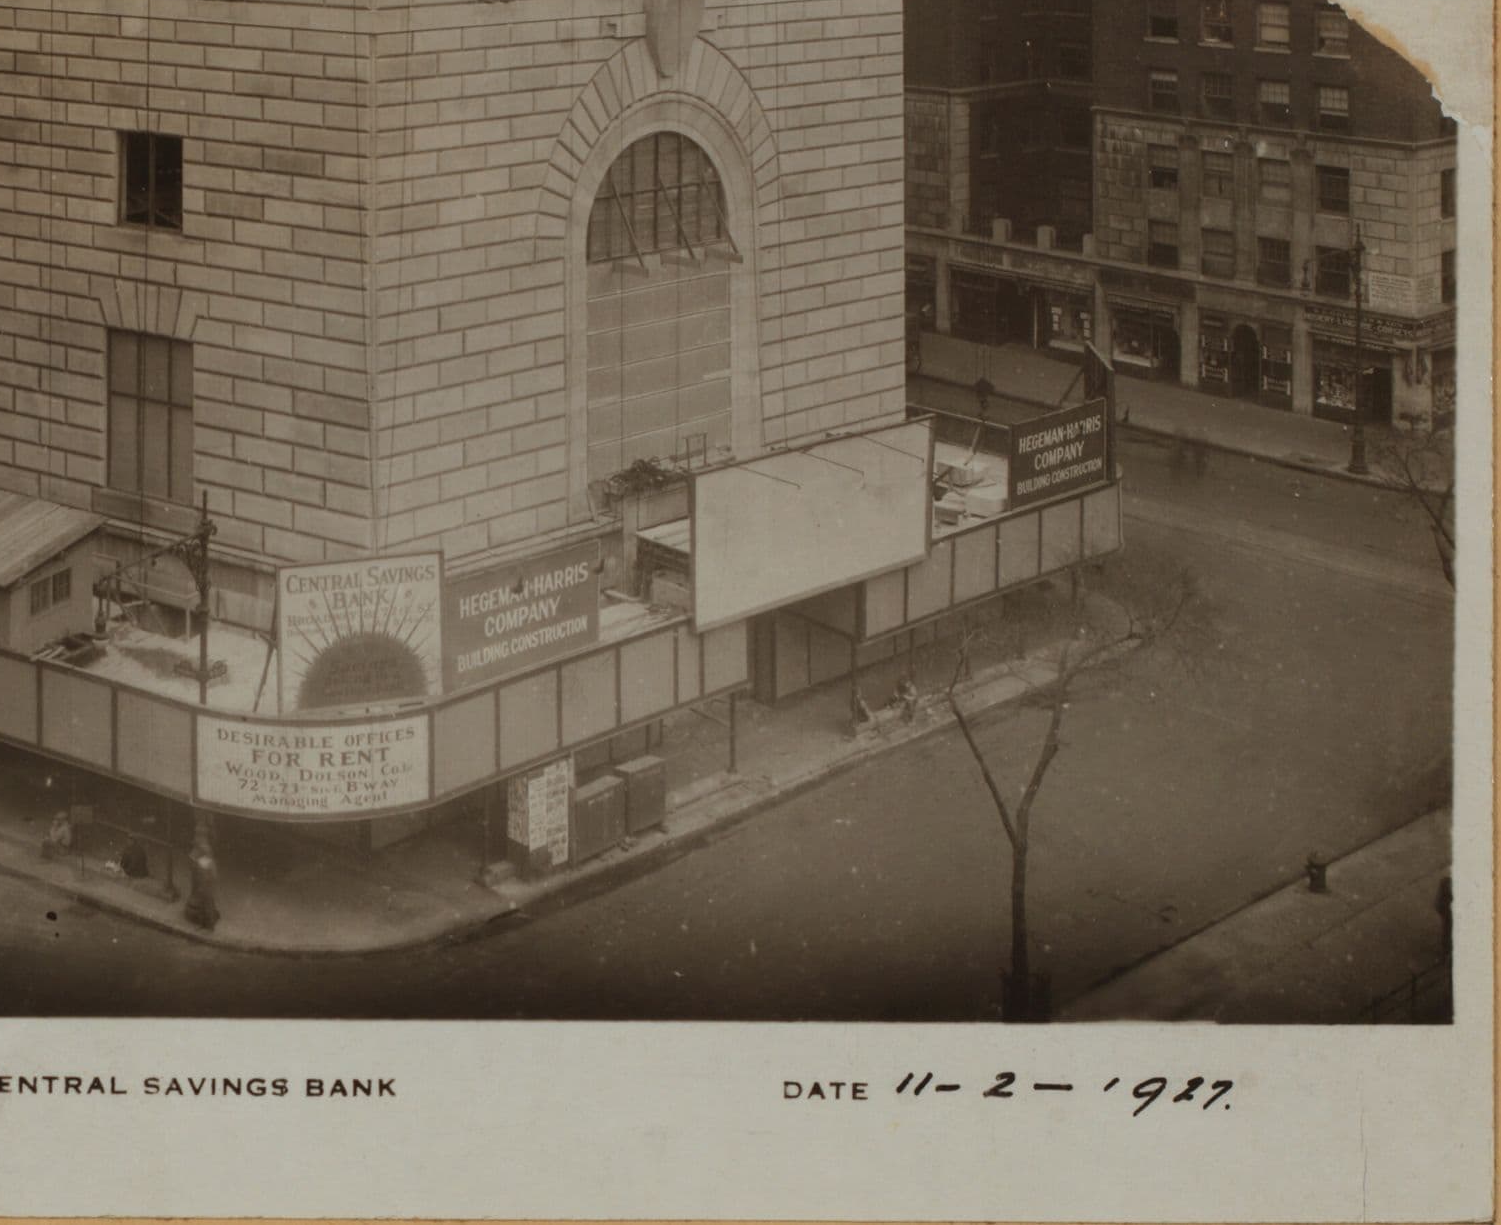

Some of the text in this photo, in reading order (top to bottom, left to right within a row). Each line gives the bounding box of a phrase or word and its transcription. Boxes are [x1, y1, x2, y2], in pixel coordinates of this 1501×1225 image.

[1034, 440, 1085, 471] COMPANY
[1016, 455, 1103, 496] BUILDING CONSTRUCTION
[286, 564, 436, 594] CENTRAL SAVINGS
[332, 587, 389, 610] BANK
[484, 593, 562, 638] COMPANY
[457, 614, 589, 673] BUILDING CONSTRUCTION
[217, 727, 415, 749] DESIRABLE OFFICES
[251, 748, 302, 767] FOR
[319, 747, 391, 768] RENT
[341, 790, 388, 806] Agent
